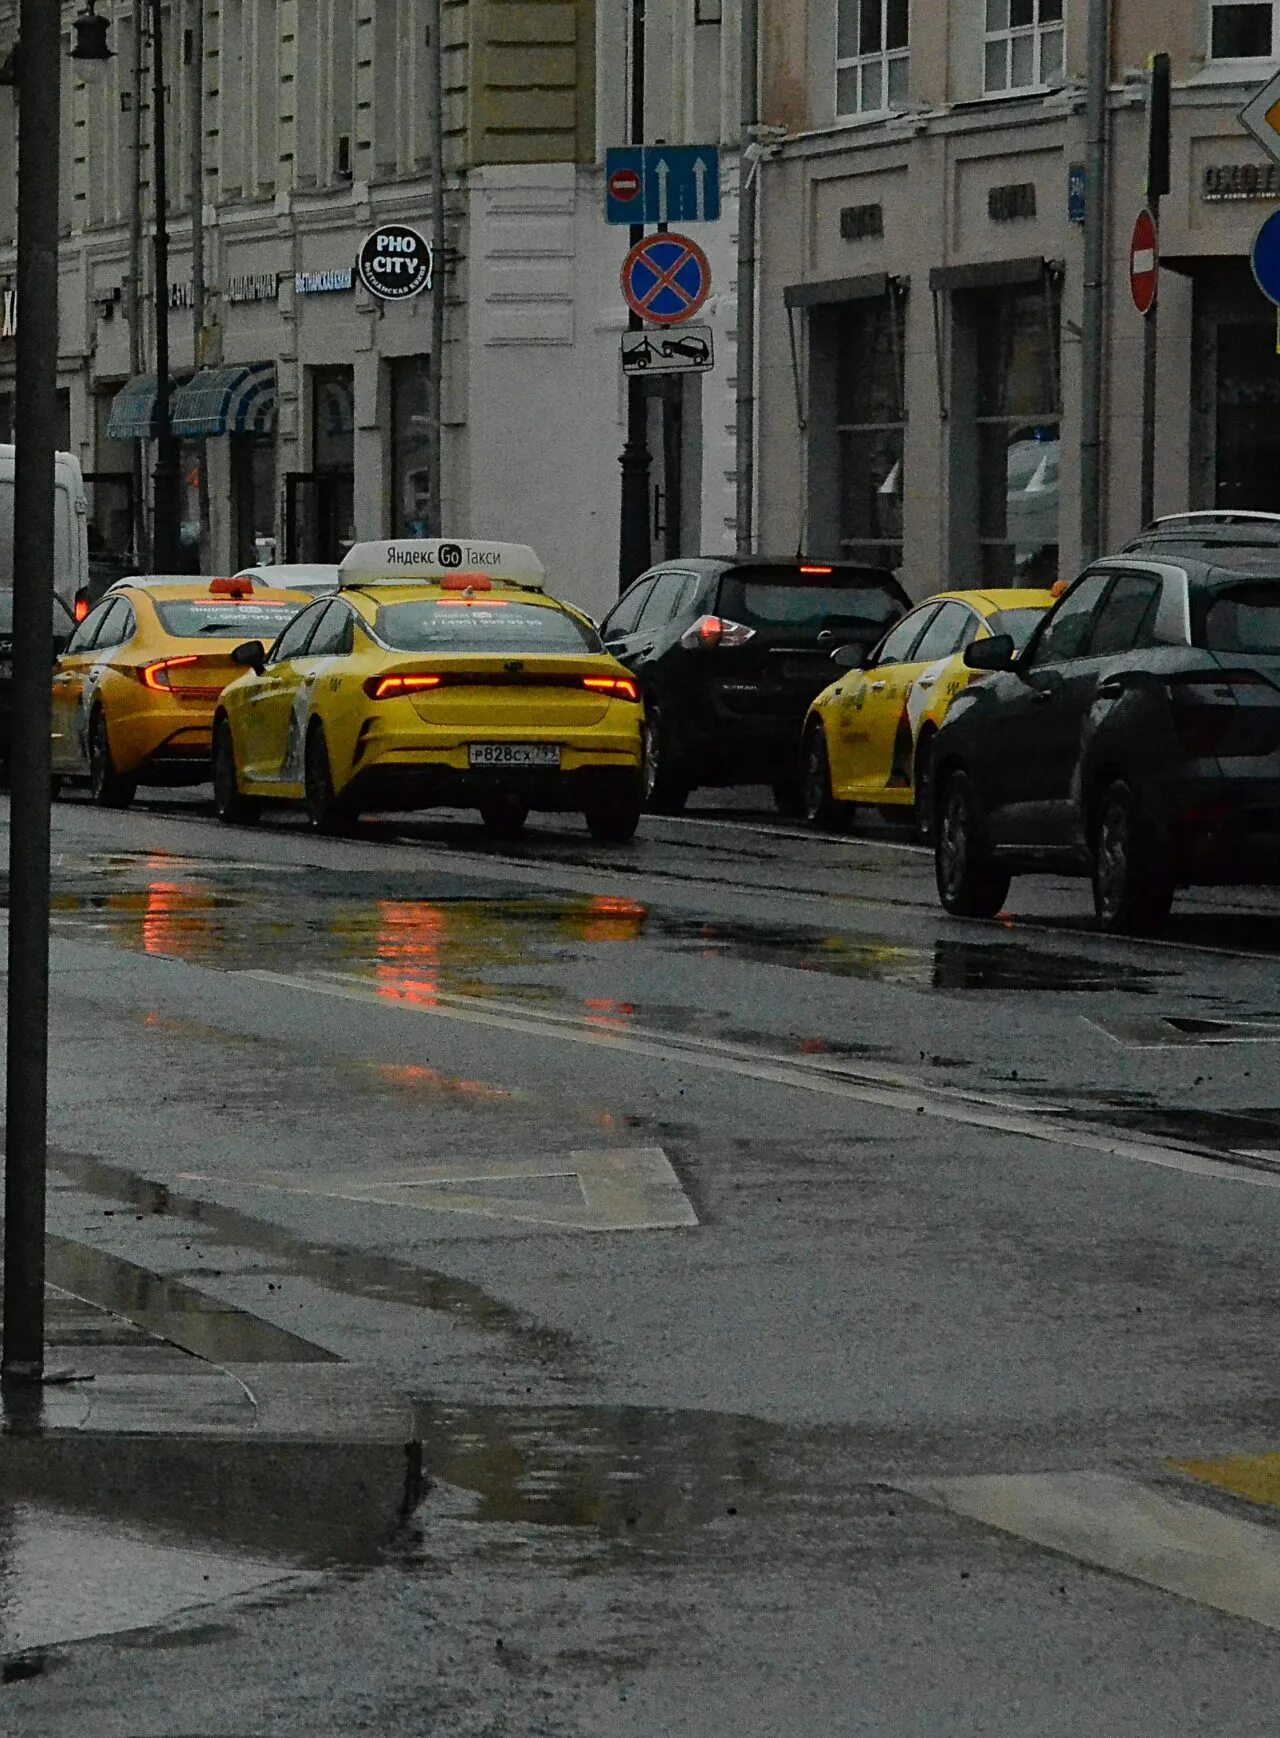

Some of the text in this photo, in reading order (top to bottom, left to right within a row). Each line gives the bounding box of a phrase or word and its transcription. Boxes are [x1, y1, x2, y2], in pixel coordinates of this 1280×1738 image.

[377, 235, 417, 253] PHO
[372, 256, 419, 274] CITY
[387, 546, 501, 565] Яндекс Go Такси
